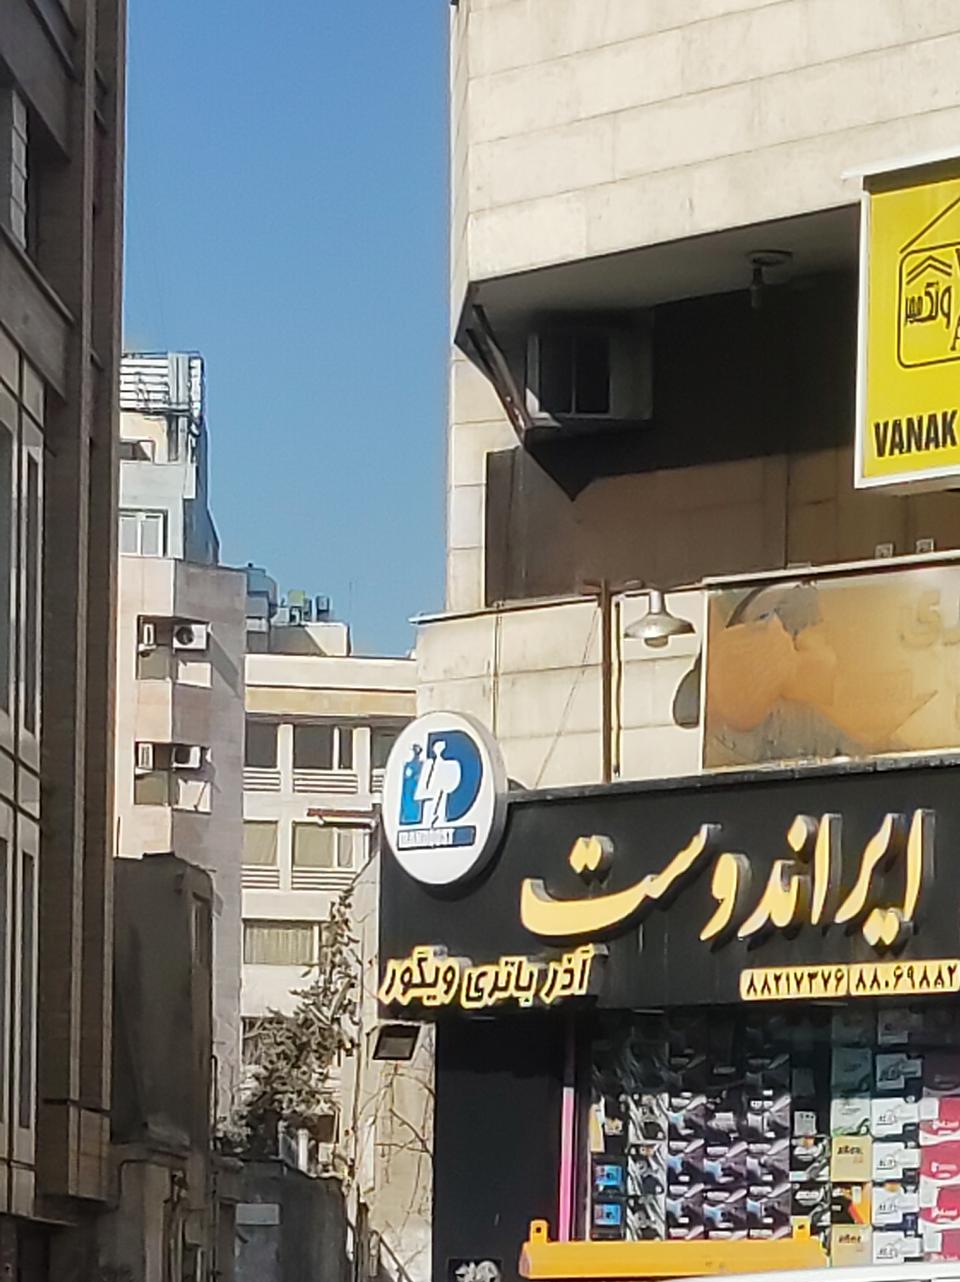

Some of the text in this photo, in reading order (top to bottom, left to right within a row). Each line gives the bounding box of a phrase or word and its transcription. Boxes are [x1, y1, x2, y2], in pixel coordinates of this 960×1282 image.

[873, 408, 958, 458] VANAK
[520, 808, 928, 946] ایراندوست
[378, 943, 596, 1009] آذر باتری ویگور
